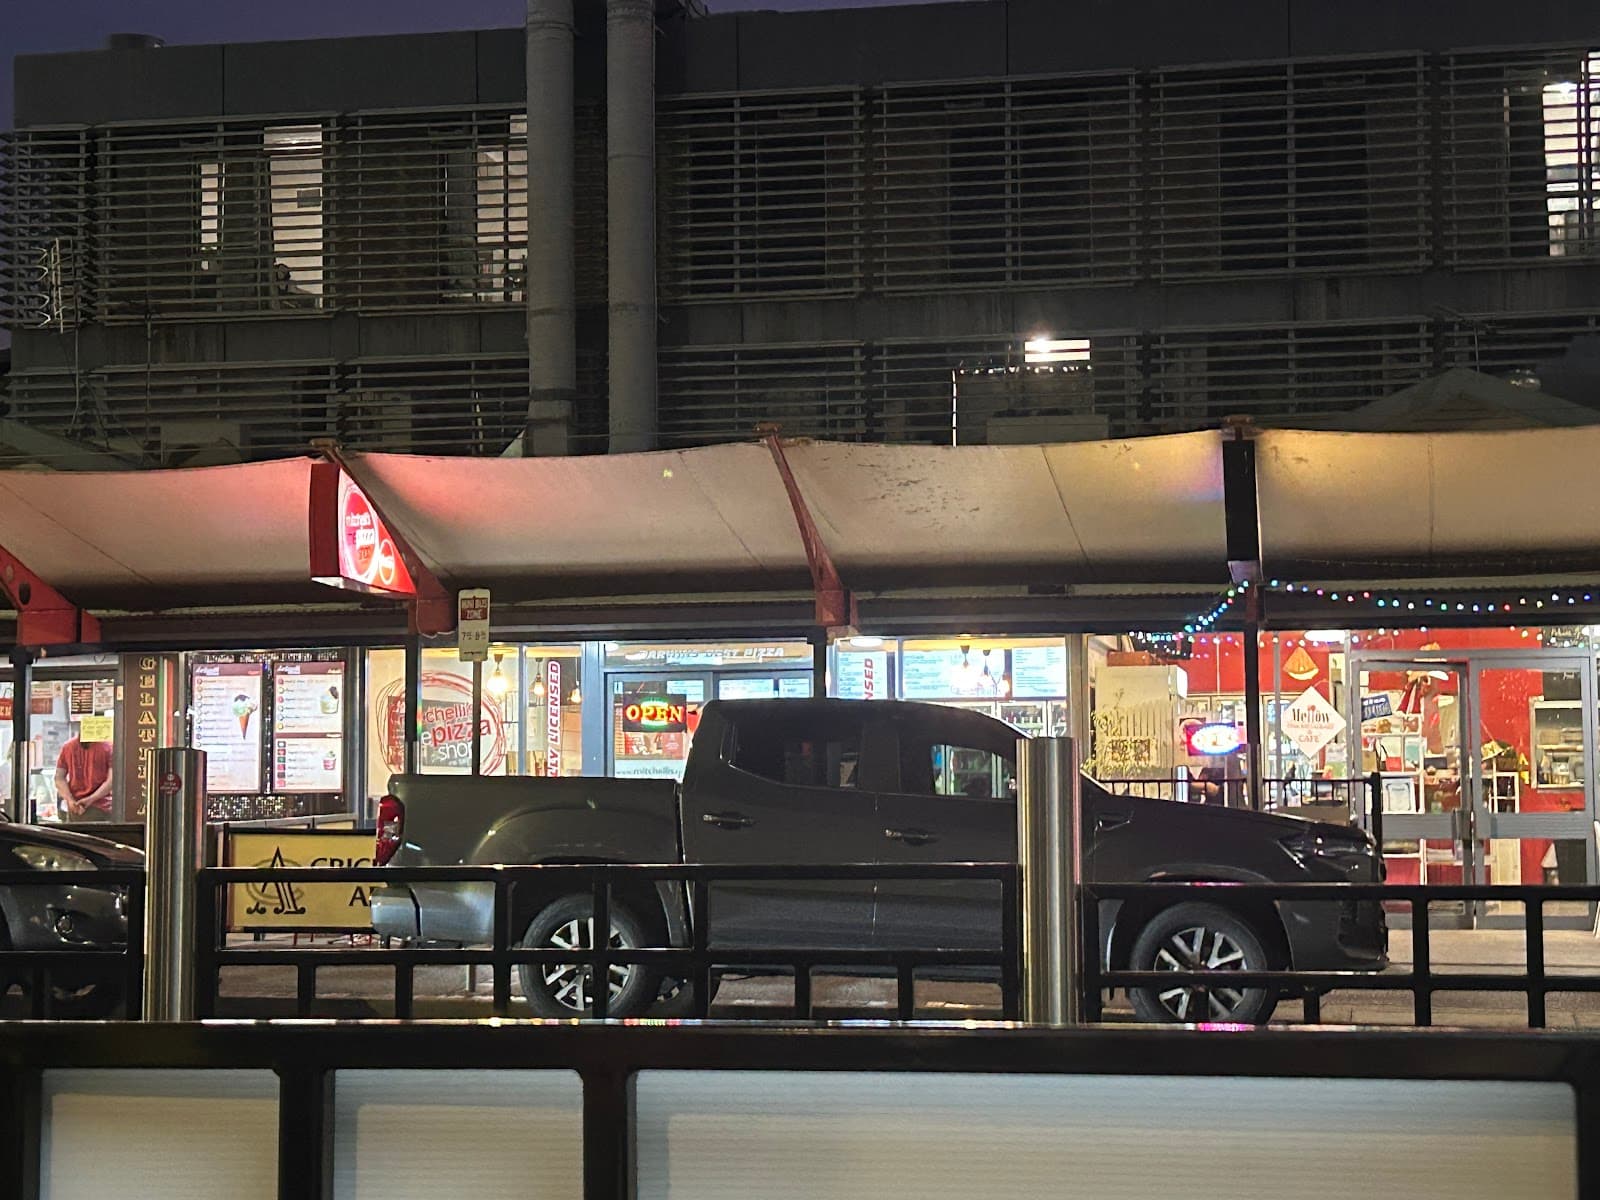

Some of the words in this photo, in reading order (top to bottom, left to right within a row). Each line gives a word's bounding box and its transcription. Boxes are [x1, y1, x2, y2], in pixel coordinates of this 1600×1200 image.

[864, 657, 874, 700] NSED
[549, 662, 560, 744] LICENSED
[625, 704, 684, 723] OPEN
